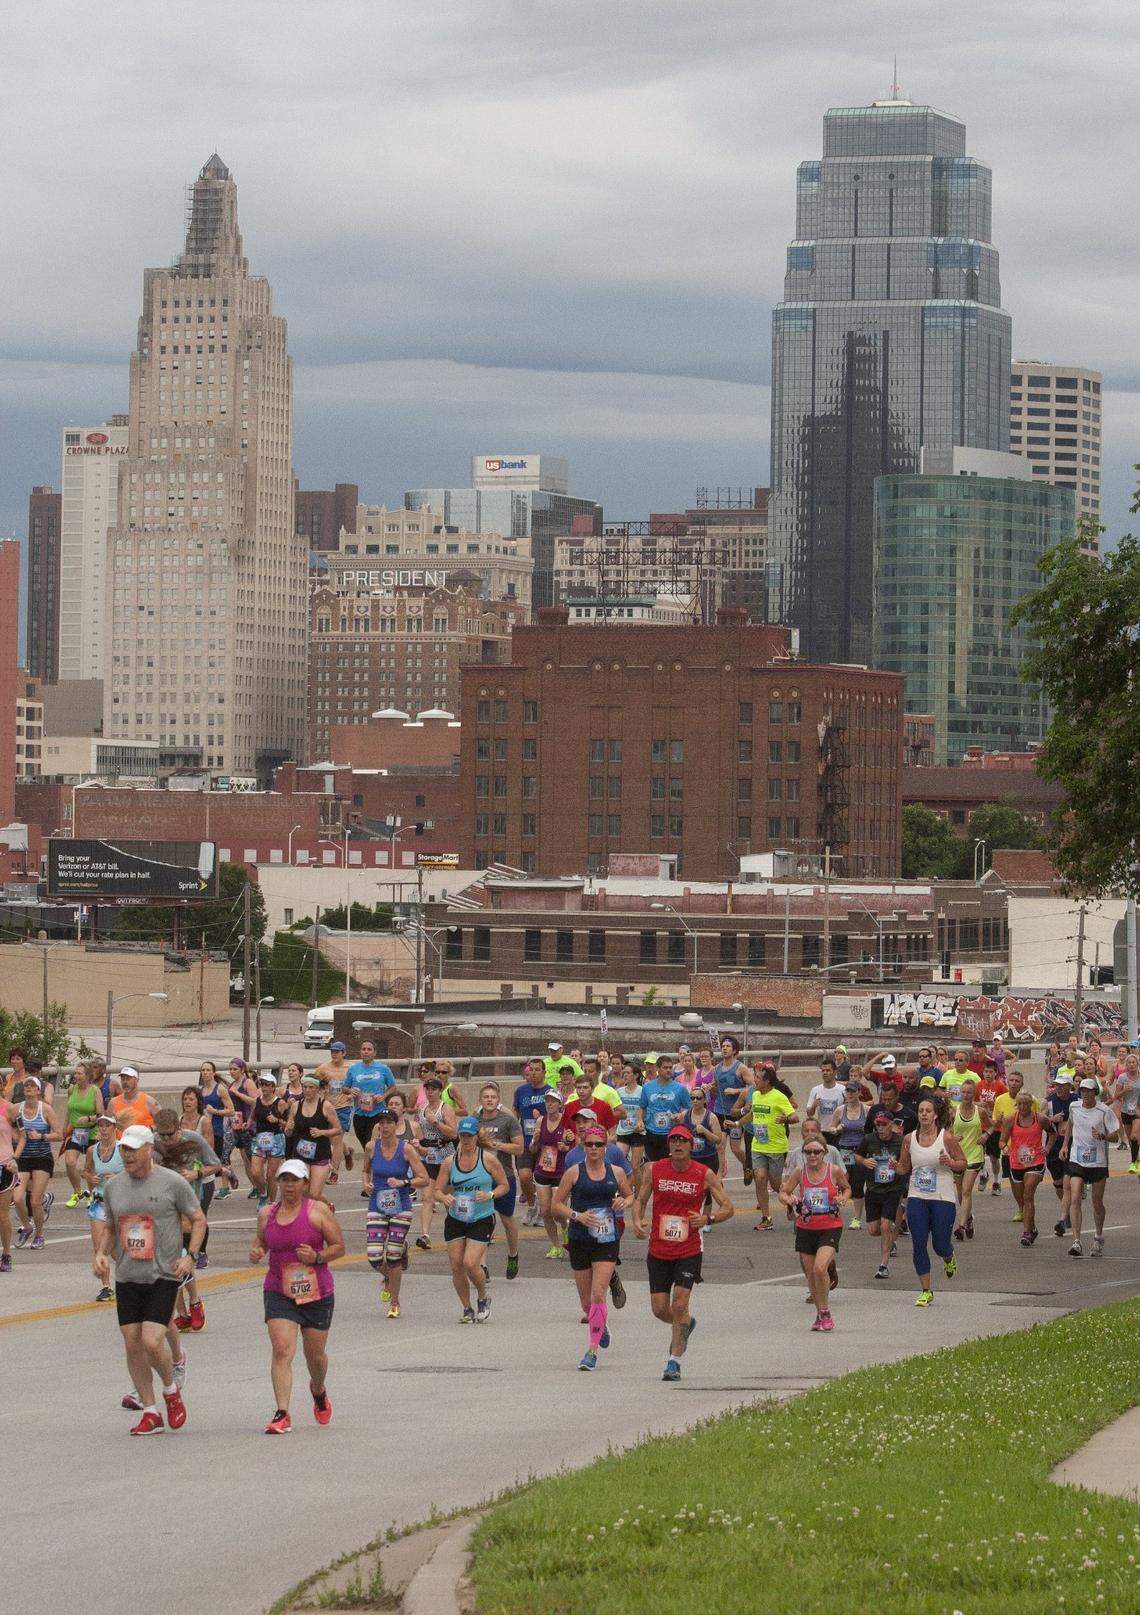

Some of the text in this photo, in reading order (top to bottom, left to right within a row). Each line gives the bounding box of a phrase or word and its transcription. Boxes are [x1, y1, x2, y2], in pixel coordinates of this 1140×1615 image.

[66, 446, 102, 455] CROWNE
[343, 570, 450, 586] PRESIDENT
[58, 854, 75, 862] Bring
[178, 882, 198, 890] Sprint
[659, 1180, 698, 1190] SPORT
